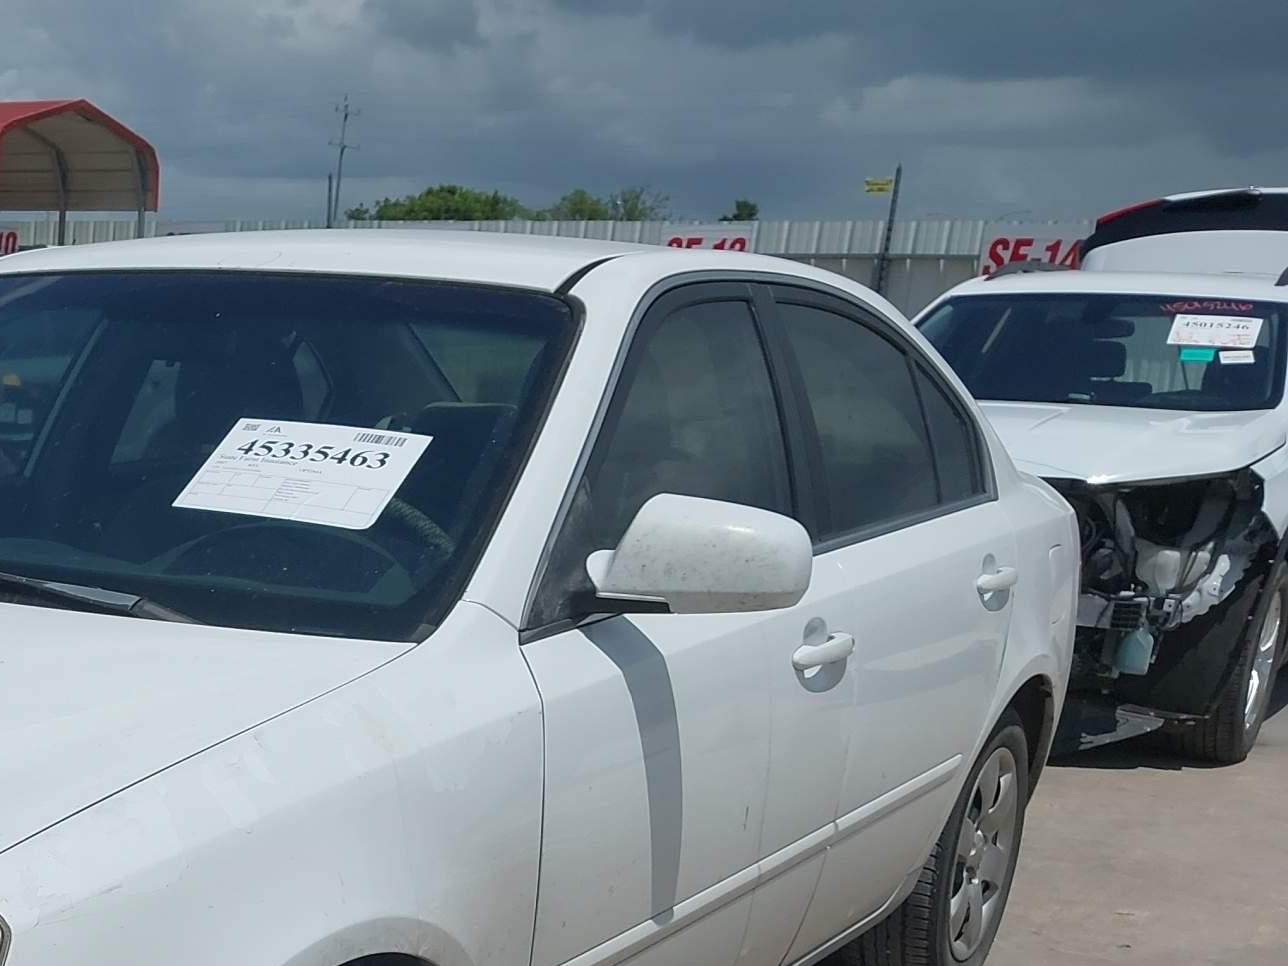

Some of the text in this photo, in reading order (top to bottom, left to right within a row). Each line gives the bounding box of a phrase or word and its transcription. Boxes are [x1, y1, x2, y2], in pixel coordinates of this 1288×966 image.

[982, 237, 1081, 275] SF-14
[1183, 321, 1250, 330] 45015246
[237, 439, 391, 469] 45335463
